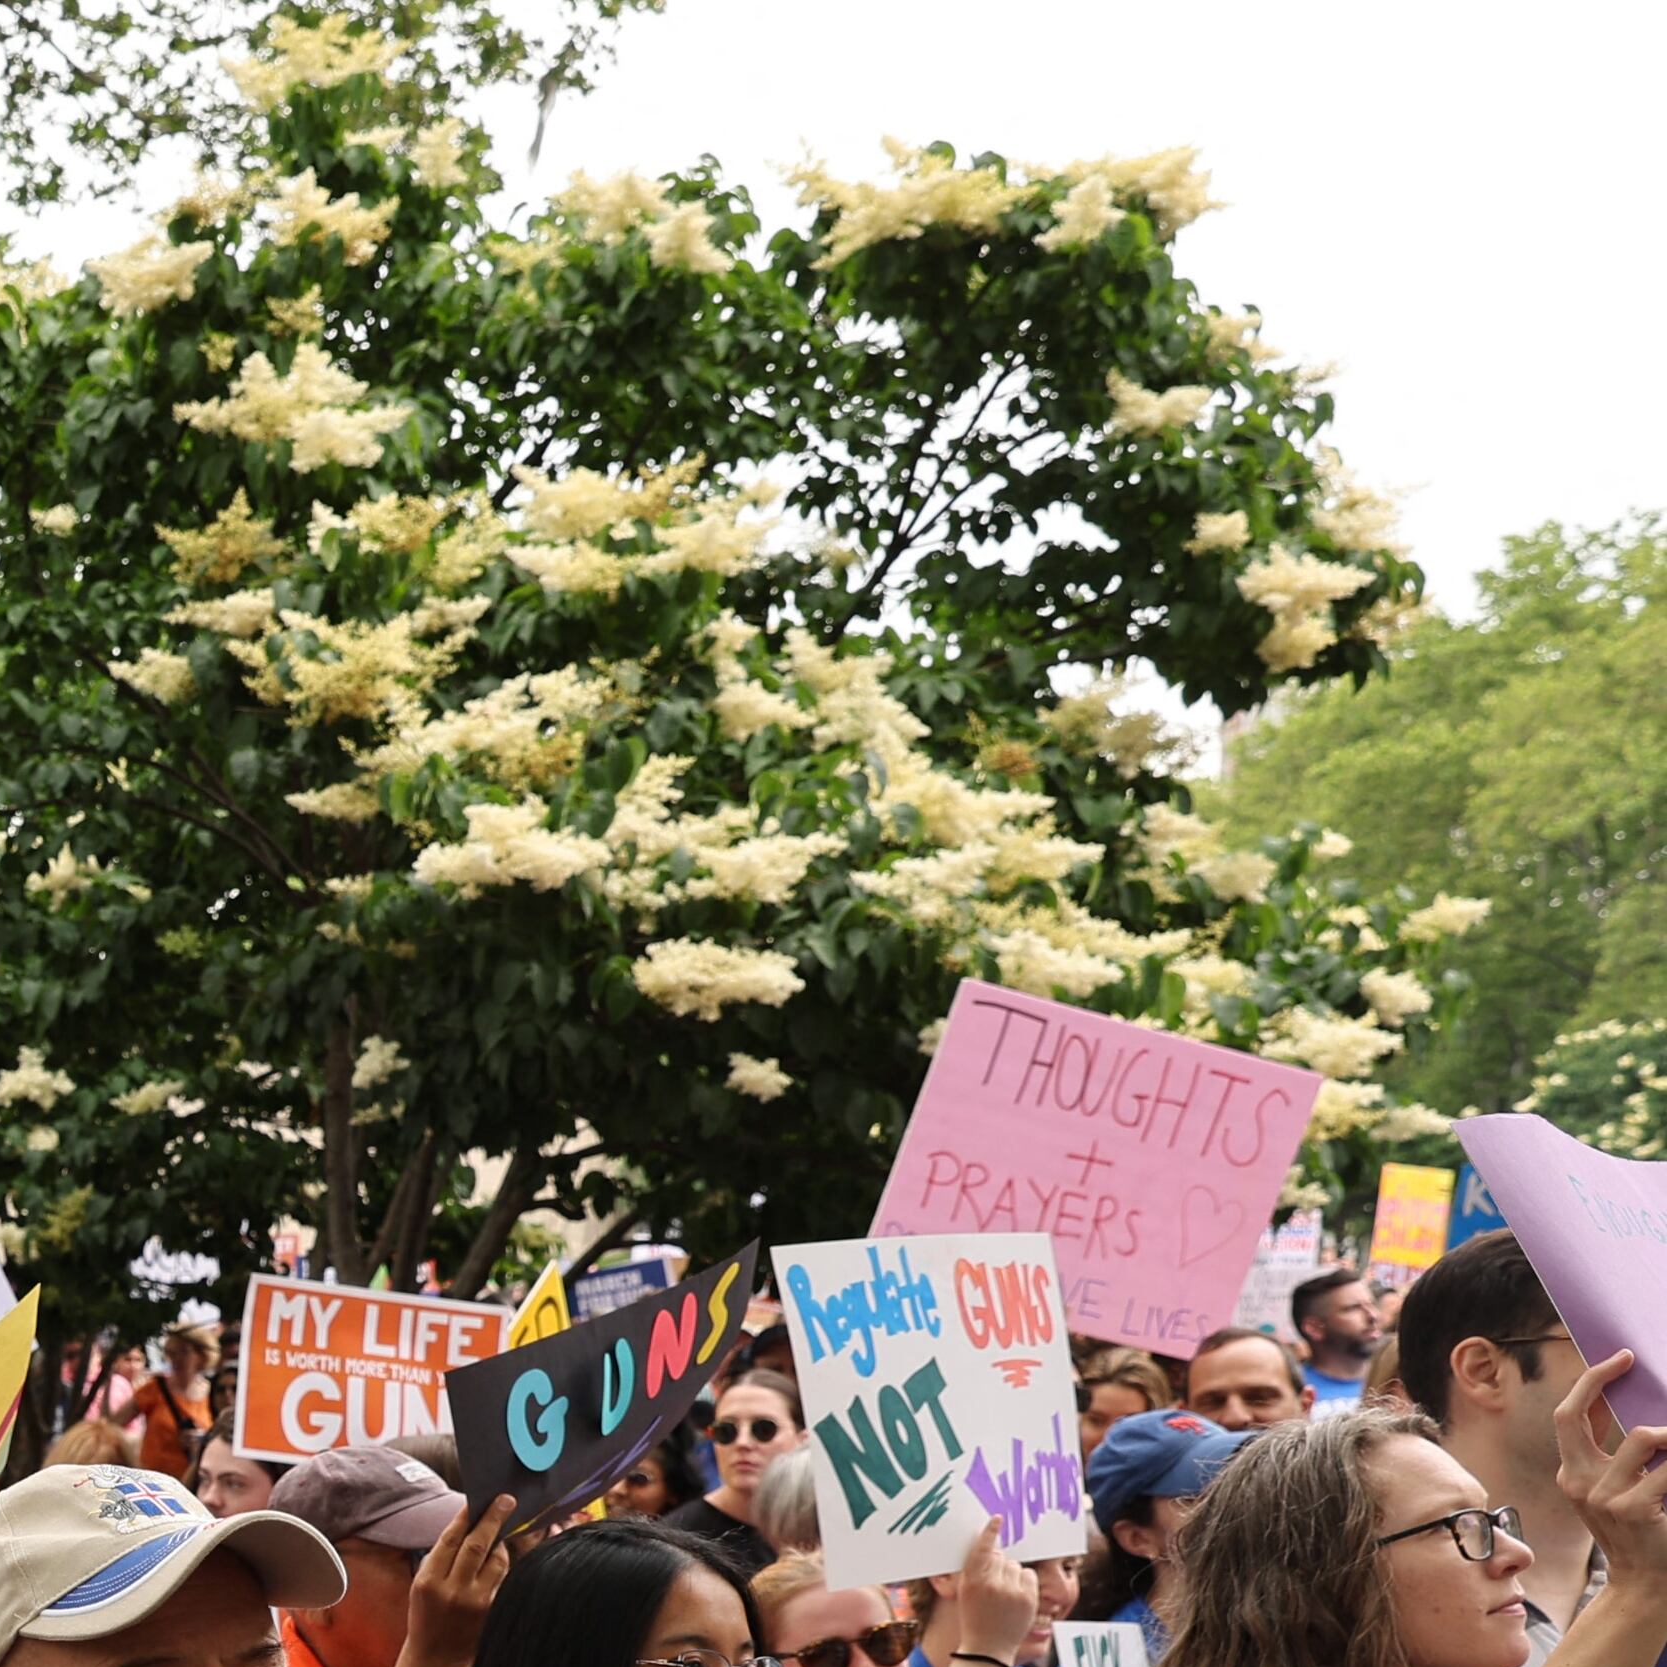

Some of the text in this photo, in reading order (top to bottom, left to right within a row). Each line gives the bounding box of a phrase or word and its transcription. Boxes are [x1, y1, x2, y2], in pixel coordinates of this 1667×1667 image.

[973, 1000, 1291, 1168] THOUGHTS
[920, 1150, 1142, 1261] PRAYERS
[267, 1290, 334, 1350] MY
[363, 1303, 485, 1368] LIFE
[953, 1258, 1053, 1350] GUNS
[265, 1349, 279, 1366] IS
[285, 1350, 342, 1374] WORTH
[345, 1358, 389, 1380] MORE
[390, 1363, 433, 1386] THAN
[506, 1261, 741, 1472] GUNS
[813, 1356, 964, 1531] NOT
